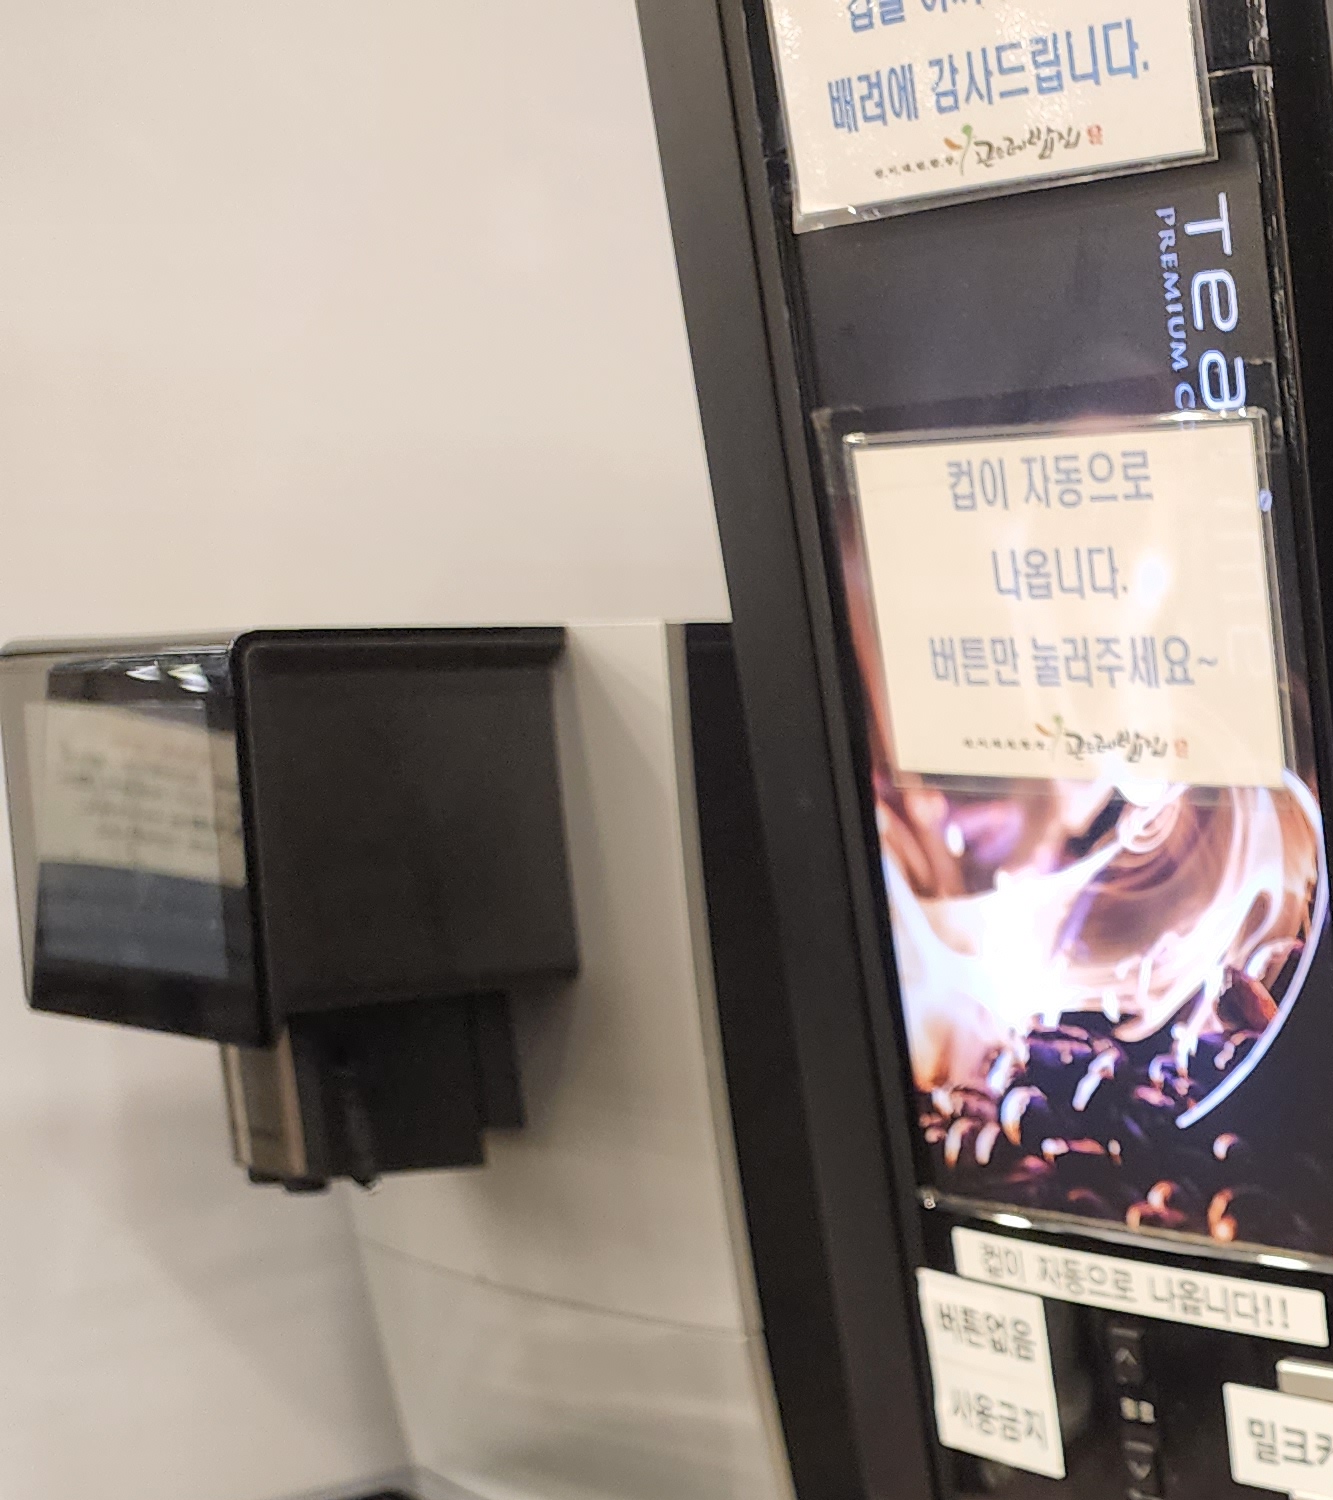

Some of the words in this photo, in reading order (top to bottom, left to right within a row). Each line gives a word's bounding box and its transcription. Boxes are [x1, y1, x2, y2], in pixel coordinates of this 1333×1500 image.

[827, 64, 918, 134] 배려에
[927, 19, 1150, 115] 감사드립니다.
[1155, 206, 1188, 373] PREMIUM
[947, 458, 1009, 511] 컵이
[1022, 449, 1153, 508] 자동으로
[991, 546, 1127, 600] 나옵니다.
[928, 636, 1022, 687] 버튼만
[1031, 635, 1219, 688] 눌러주세요~
[977, 1241, 1026, 1283] 컵이
[1037, 1254, 1138, 1303] 자동으로
[1147, 1276, 1290, 1331] 나옵니다!!
[935, 1303, 1037, 1362] 버튼없음
[949, 1388, 1049, 1451] 사용금지
